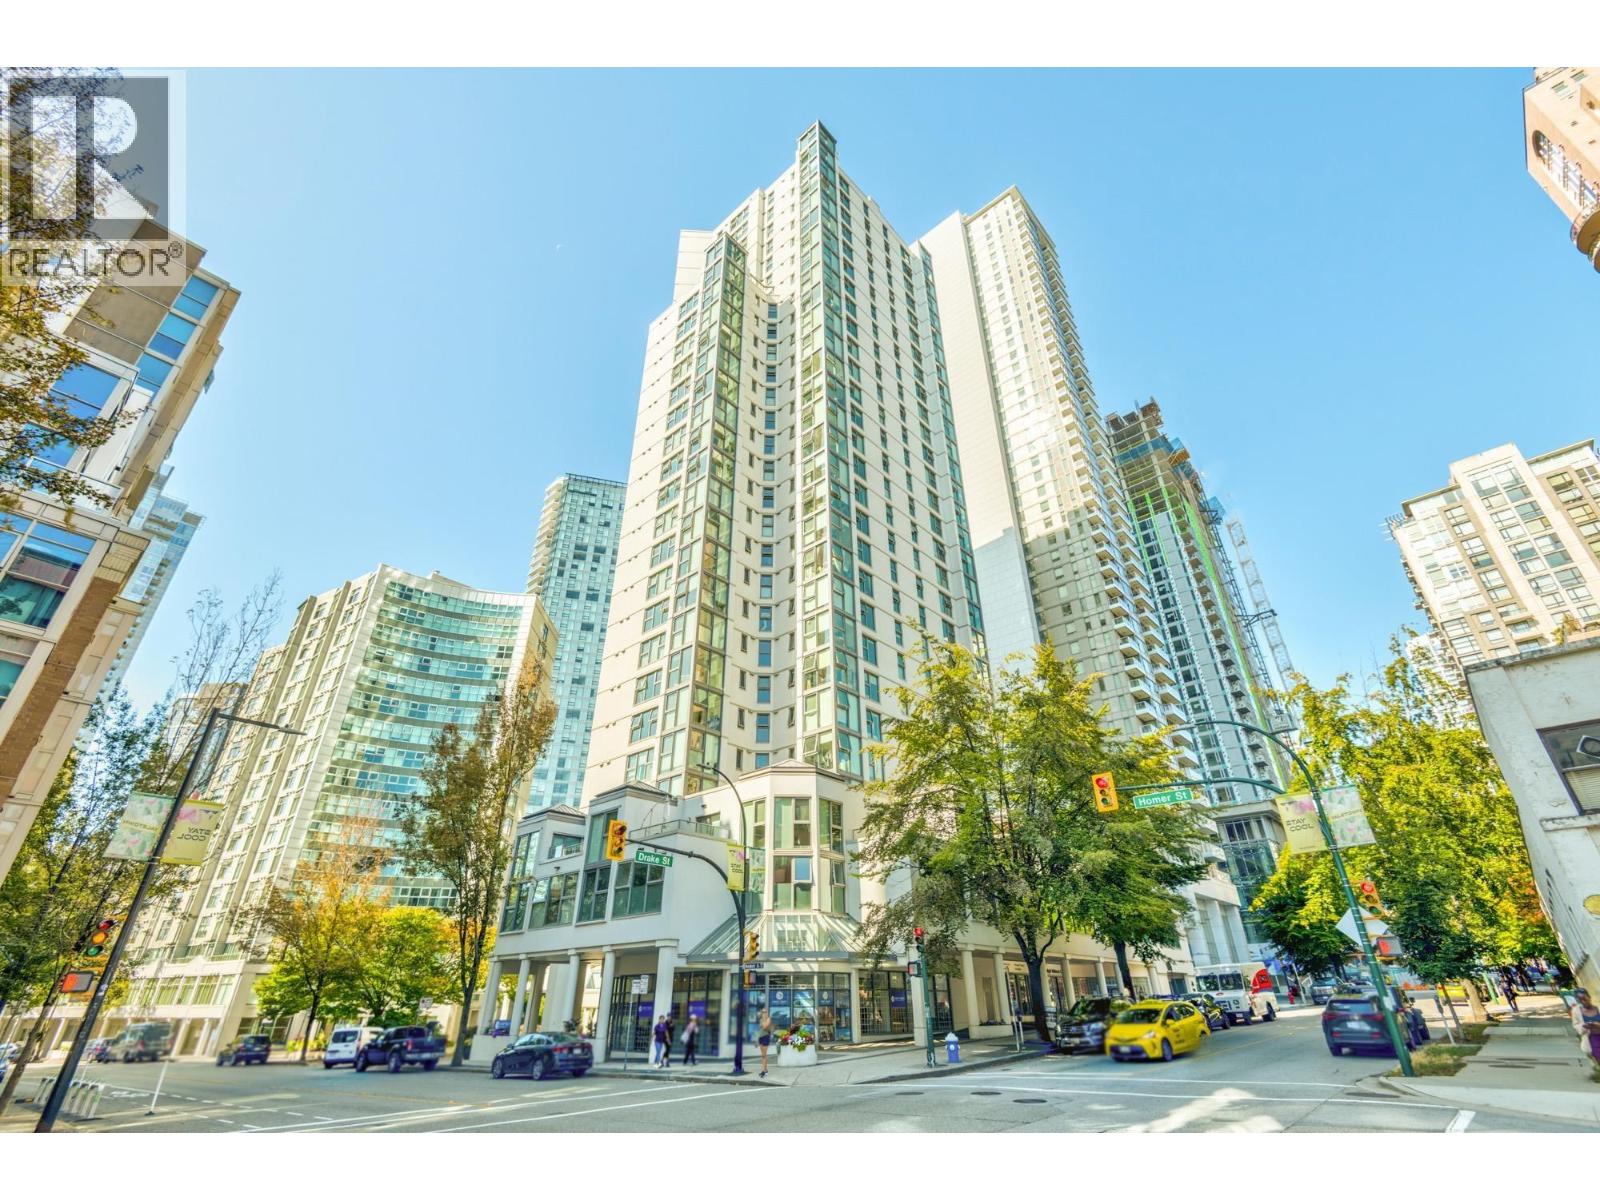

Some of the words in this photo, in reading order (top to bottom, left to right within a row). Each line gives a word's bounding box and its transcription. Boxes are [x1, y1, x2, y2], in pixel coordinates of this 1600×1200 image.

[1138, 795, 1171, 806] Homer
[1175, 791, 1188, 801] St
[1287, 818, 1306, 826] STAY
[1289, 823, 1315, 832] COOL
[638, 852, 660, 864] Drake
[662, 856, 670, 865] St
